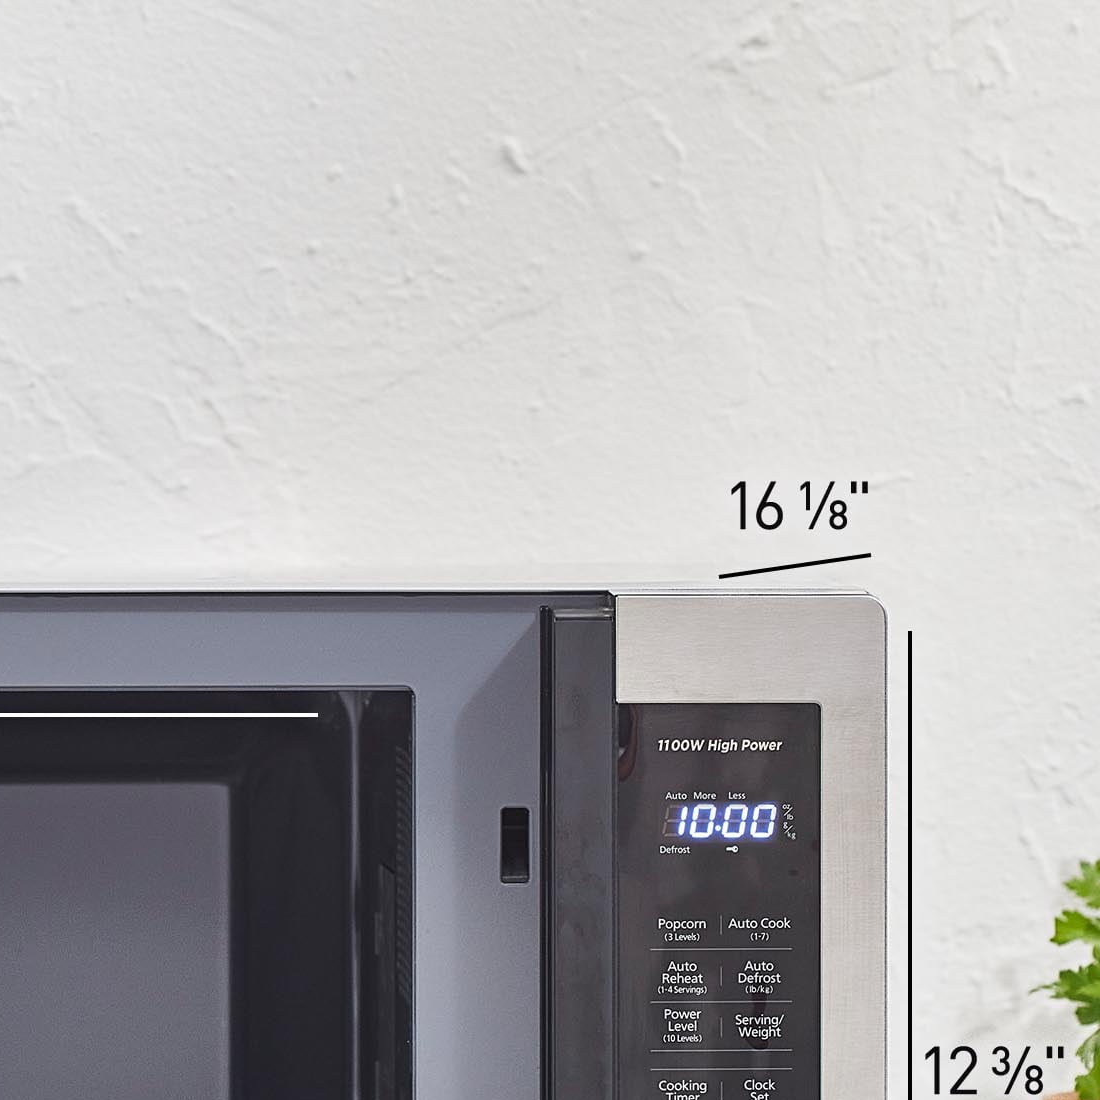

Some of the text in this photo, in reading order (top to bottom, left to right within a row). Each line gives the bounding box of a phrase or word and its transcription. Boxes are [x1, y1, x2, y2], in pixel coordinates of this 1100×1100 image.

[658, 739, 782, 753] 1100W High Power
[665, 792, 687, 800] Auto
[660, 845, 690, 853] Defrost
[659, 919, 706, 931] Popcorn
[728, 917, 791, 928] Auto Cook
[665, 933, 700, 941] (3 Levels)
[751, 933, 769, 941] (1-7)
[668, 961, 697, 971] Auto
[744, 961, 774, 971] Auto
[662, 973, 703, 984] Reheat
[738, 972, 781, 983] Defrost
[658, 985, 707, 995] (1-4 Servings)
[745, 985, 773, 994] (lb/kg)
[664, 1009, 701, 1019] Power
[669, 1020, 697, 1031] Level
[735, 1014, 784, 1027] Serving/
[738, 1026, 781, 1039] Weight
[663, 1034, 702, 1043] (10 Levels)
[659, 1080, 707, 1094] Cooking
[744, 1079, 775, 1090] Clock
